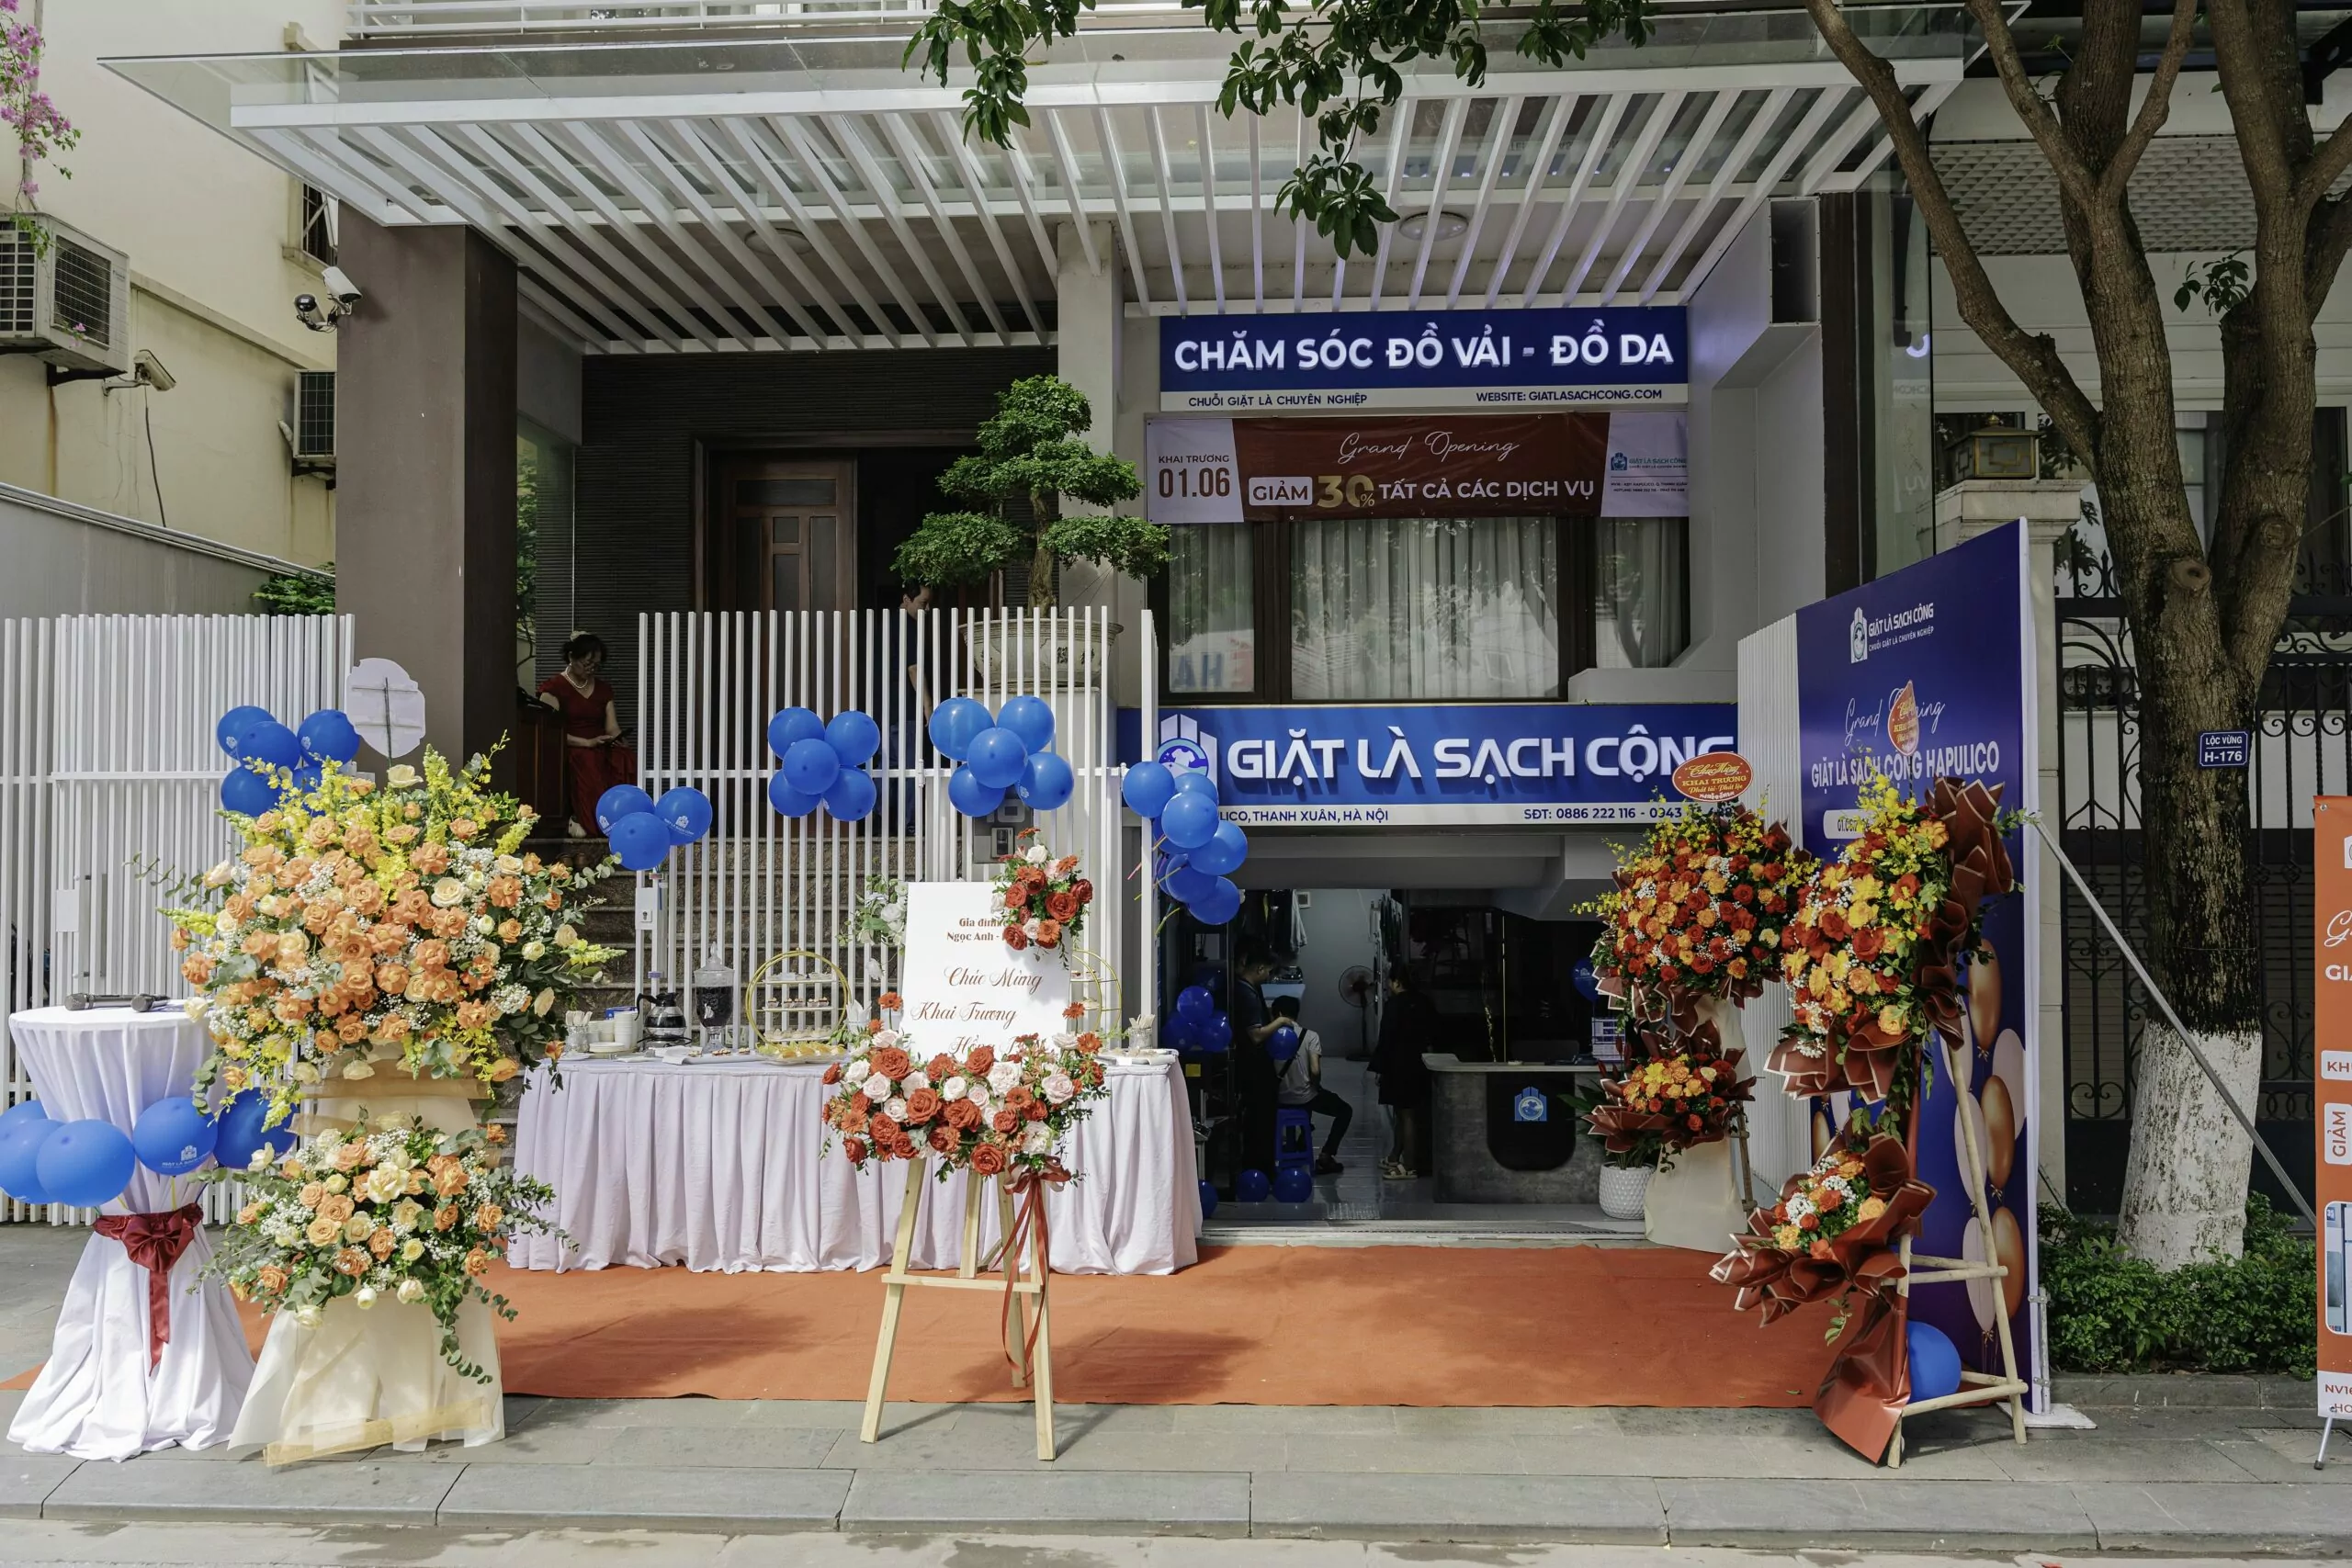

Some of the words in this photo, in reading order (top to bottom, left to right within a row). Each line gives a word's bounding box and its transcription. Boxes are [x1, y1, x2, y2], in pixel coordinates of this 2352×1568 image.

[1174, 330, 1284, 371] CHĂM
[1296, 328, 1373, 370] SÓC
[1385, 321, 1443, 368] ĐỒ
[1452, 324, 1510, 367] VẢI
[1549, 319, 1609, 366] ĐỒ
[1620, 333, 1674, 365] DA
[1188, 392, 1224, 407] CHUỖI
[1227, 395, 1254, 408] GIẶT
[1259, 394, 1272, 406] LÀ
[1276, 393, 1321, 406] CHUYÊN
[1327, 392, 1367, 407] NGHIỆP
[1476, 391, 1526, 402] WEBSITE:
[1529, 389, 1662, 401] GIATLASACHCONG.COM
[1337, 432, 1412, 464] Grand
[1424, 431, 1520, 462] Opening
[1186, 455, 1229, 463] TRƯƠNG
[1159, 467, 1230, 498] 01.06
[1252, 479, 1308, 501] GIẢM
[1379, 479, 1417, 500] TẤT
[1422, 478, 1452, 499] CẢ
[1457, 479, 1499, 498] CÁC
[1507, 480, 1558, 501] DỊCH
[1564, 480, 1594, 500] VỤ
[1845, 698, 1883, 747] Grand
[2205, 735, 2221, 746] LỘC
[1227, 728, 1345, 786] GIẶT
[1357, 726, 1422, 778] LÀ
[1433, 738, 1575, 784] SẠCH
[2204, 750, 2243, 762] H-176
[1812, 756, 1833, 795] GIẶT
[1836, 752, 1849, 785] LÀ
[1927, 740, 1999, 779] HAPULICO
[1252, 811, 1296, 822] THANH
[1300, 809, 1340, 823] XUÂN,
[1343, 809, 1362, 821] HÀ
[1366, 809, 1388, 824] NỘI
[1523, 808, 1552, 819] SĐT:
[1556, 808, 1589, 819] 0886
[1592, 808, 1615, 818] 222
[1618, 808, 1635, 818] 116
[959, 918, 975, 927] Gia
[946, 932, 972, 943] Ngọc
[974, 932, 994, 942] Anh
[910, 1001, 957, 1021] Khai
[2327, 1111, 2346, 1157] GIẢM
